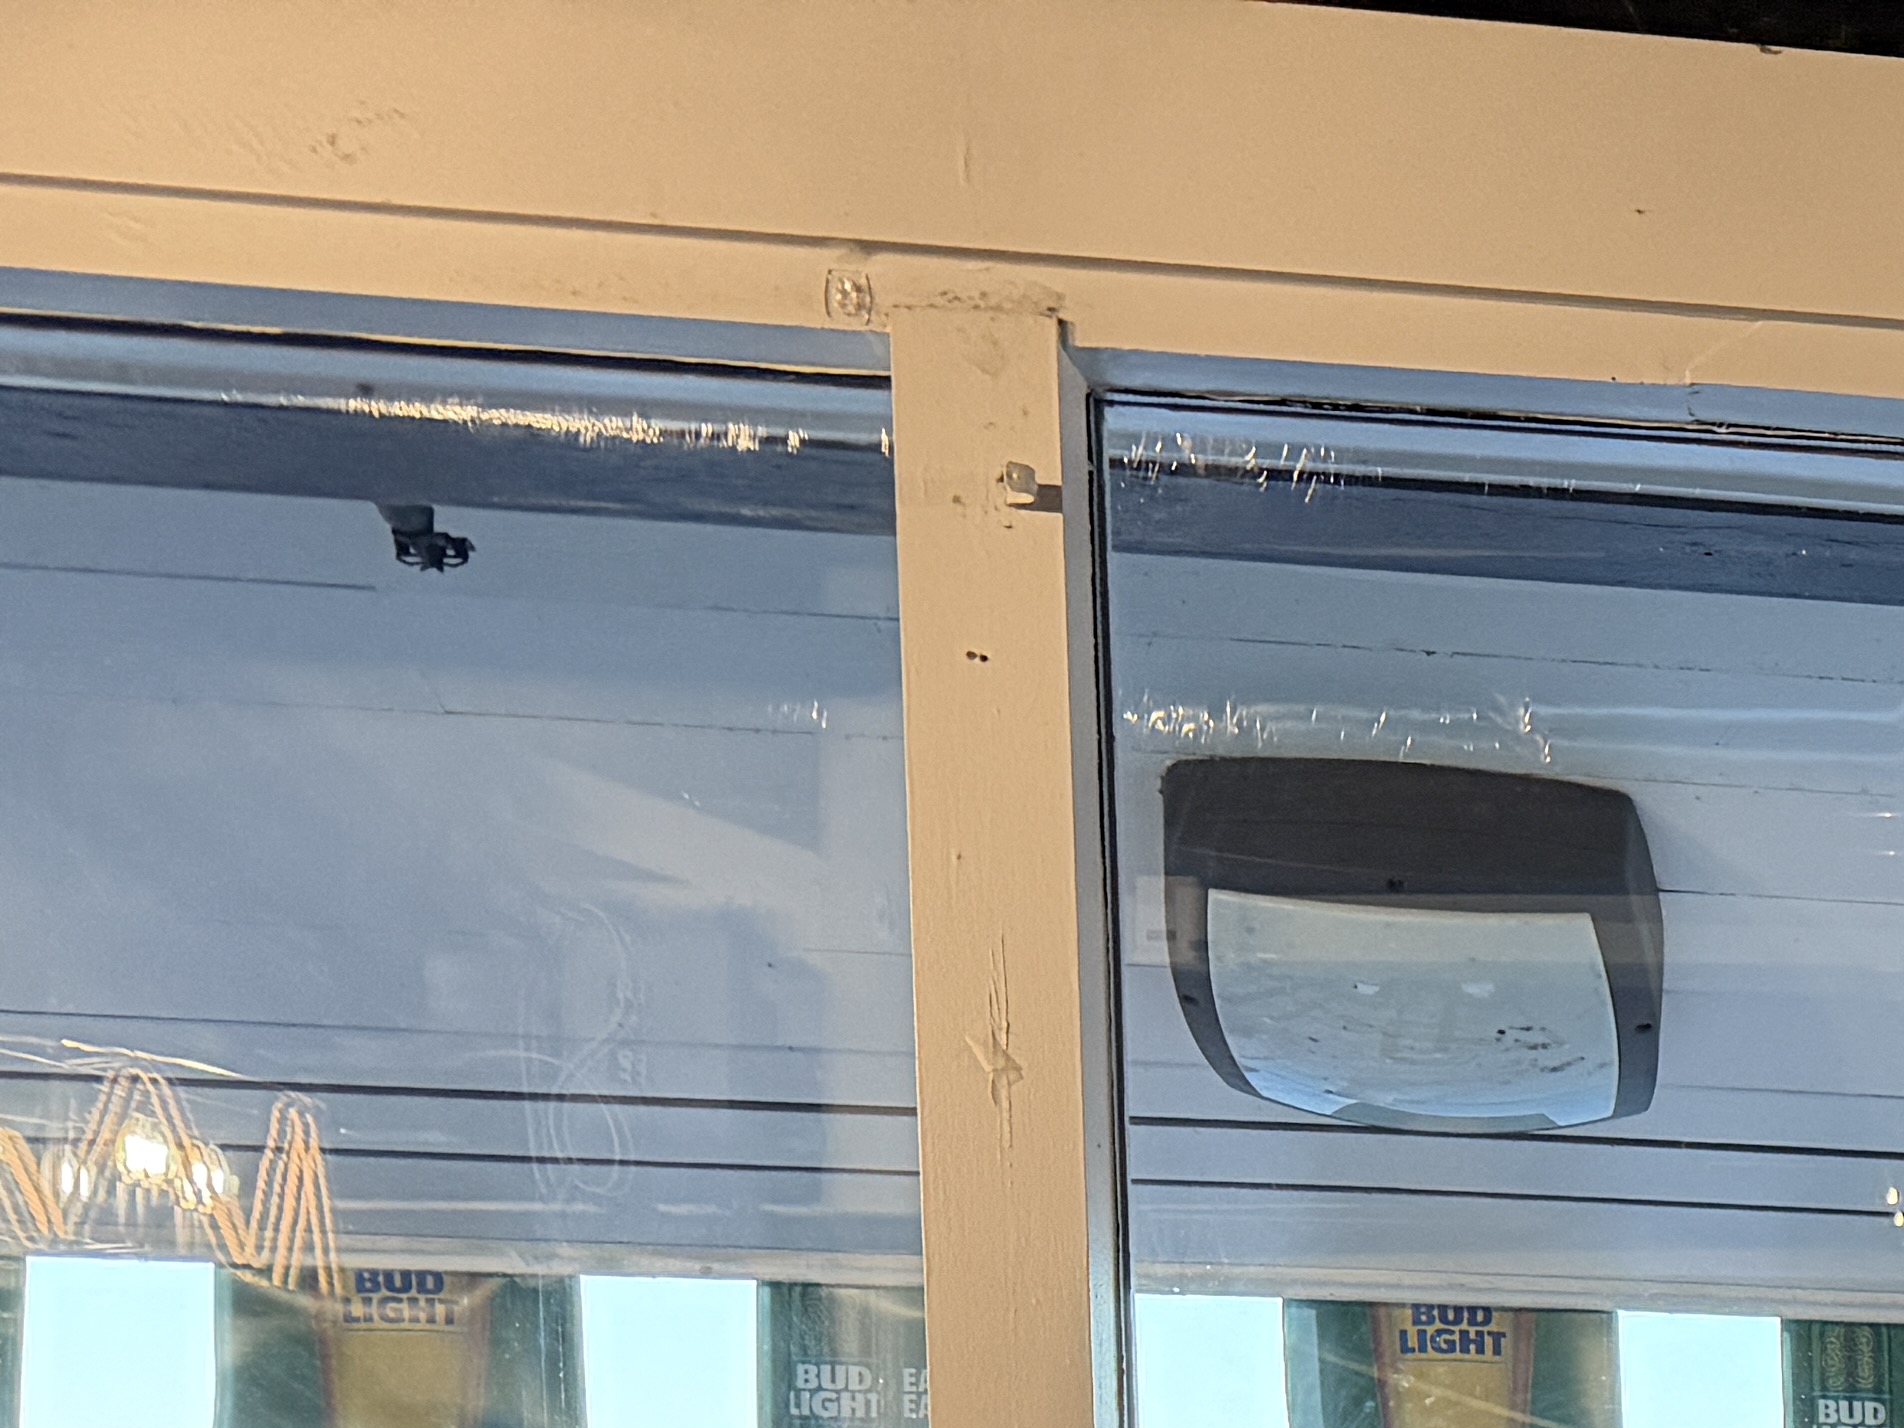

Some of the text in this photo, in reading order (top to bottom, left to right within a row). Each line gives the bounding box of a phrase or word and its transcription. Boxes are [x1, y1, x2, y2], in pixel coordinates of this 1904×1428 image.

[355, 1268, 444, 1294] BUD
[343, 1296, 459, 1325] LIGHT
[1411, 1304, 1493, 1327] BUD
[1399, 1329, 1507, 1356] LIGHT
[796, 1363, 872, 1390] BUD
[789, 1390, 879, 1418] LIGHT
[1818, 1399, 1886, 1426] BUD
